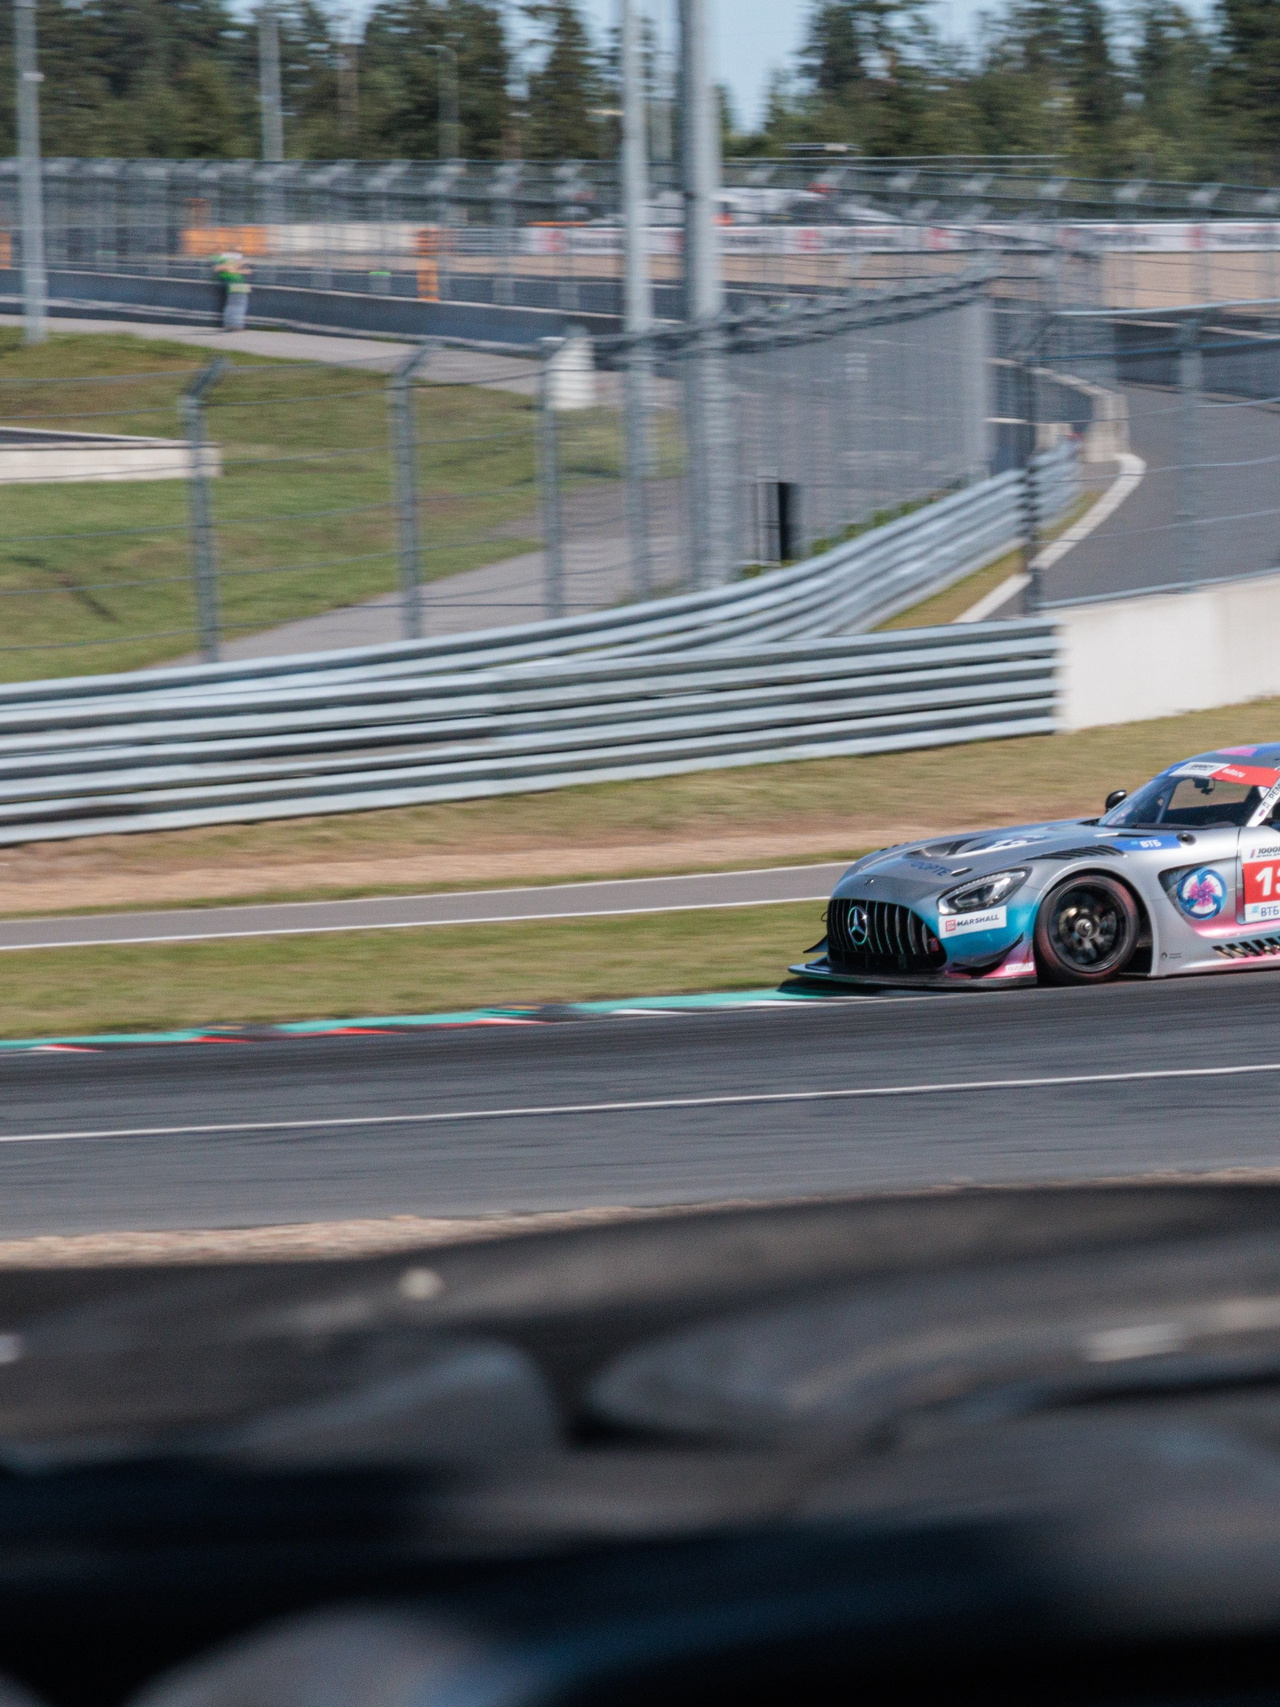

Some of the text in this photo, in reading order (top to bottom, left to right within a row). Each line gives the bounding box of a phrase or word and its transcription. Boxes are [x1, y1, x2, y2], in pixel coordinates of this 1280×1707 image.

[1140, 839, 1162, 848] ВТБ
[1260, 905, 1280, 917] ВТБ
[956, 914, 1000, 927] MARSHALL
